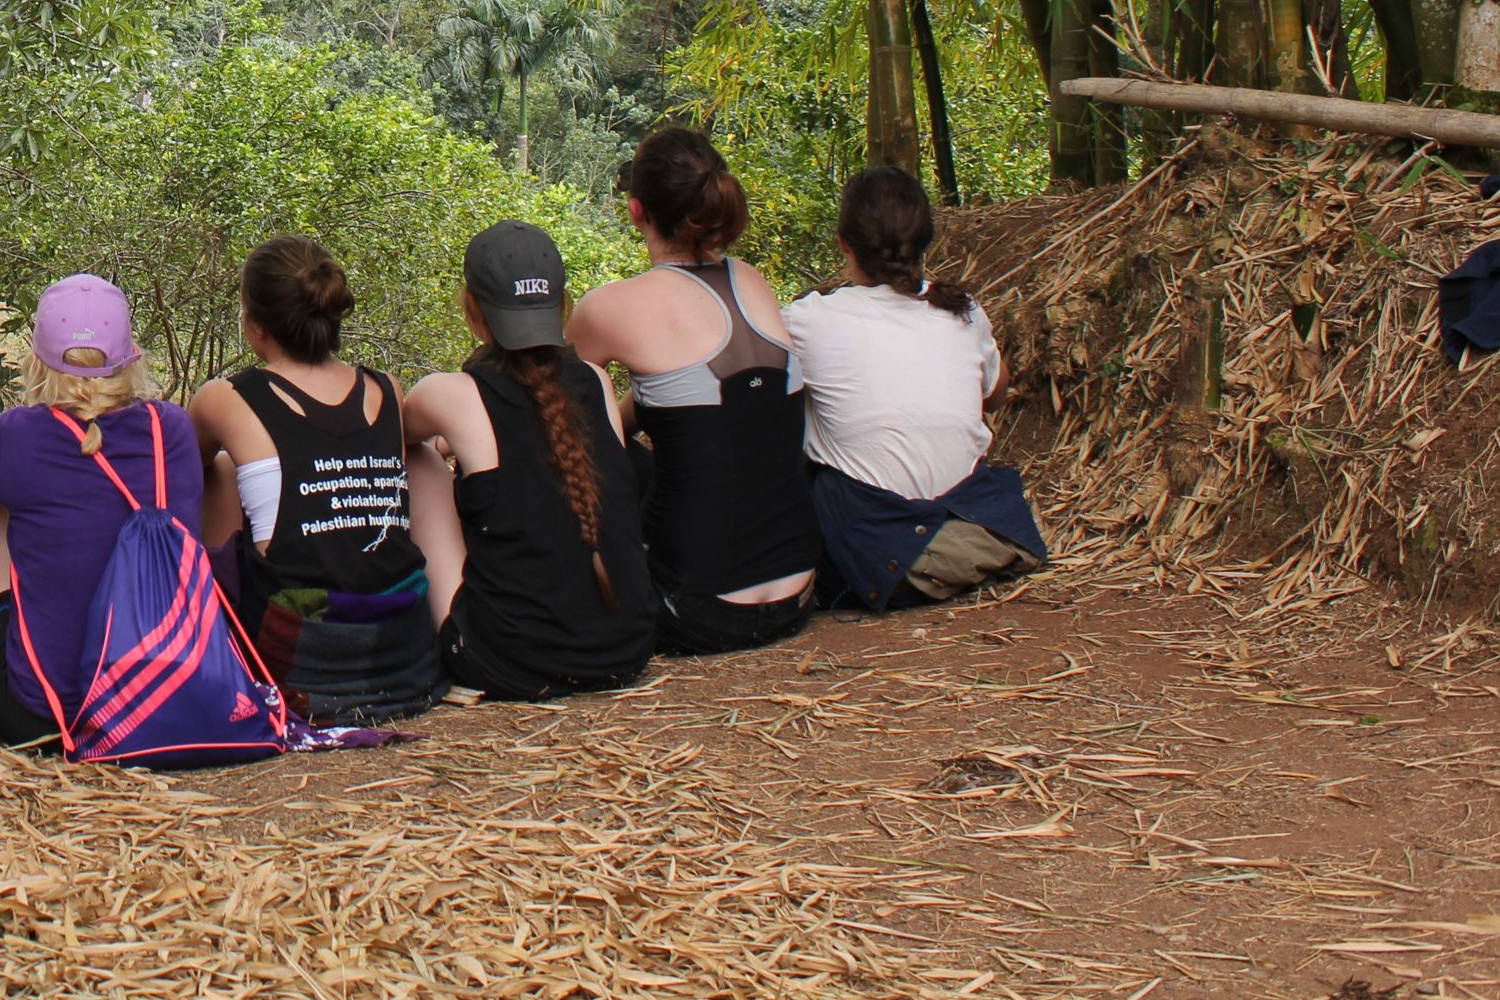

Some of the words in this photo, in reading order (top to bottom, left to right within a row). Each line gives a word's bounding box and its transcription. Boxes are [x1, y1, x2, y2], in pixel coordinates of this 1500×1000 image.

[514, 278, 549, 296] NIKE
[314, 458, 343, 472] Help
[346, 456, 367, 469] end
[369, 456, 402, 469] Israel's
[300, 476, 371, 495] Occupation,
